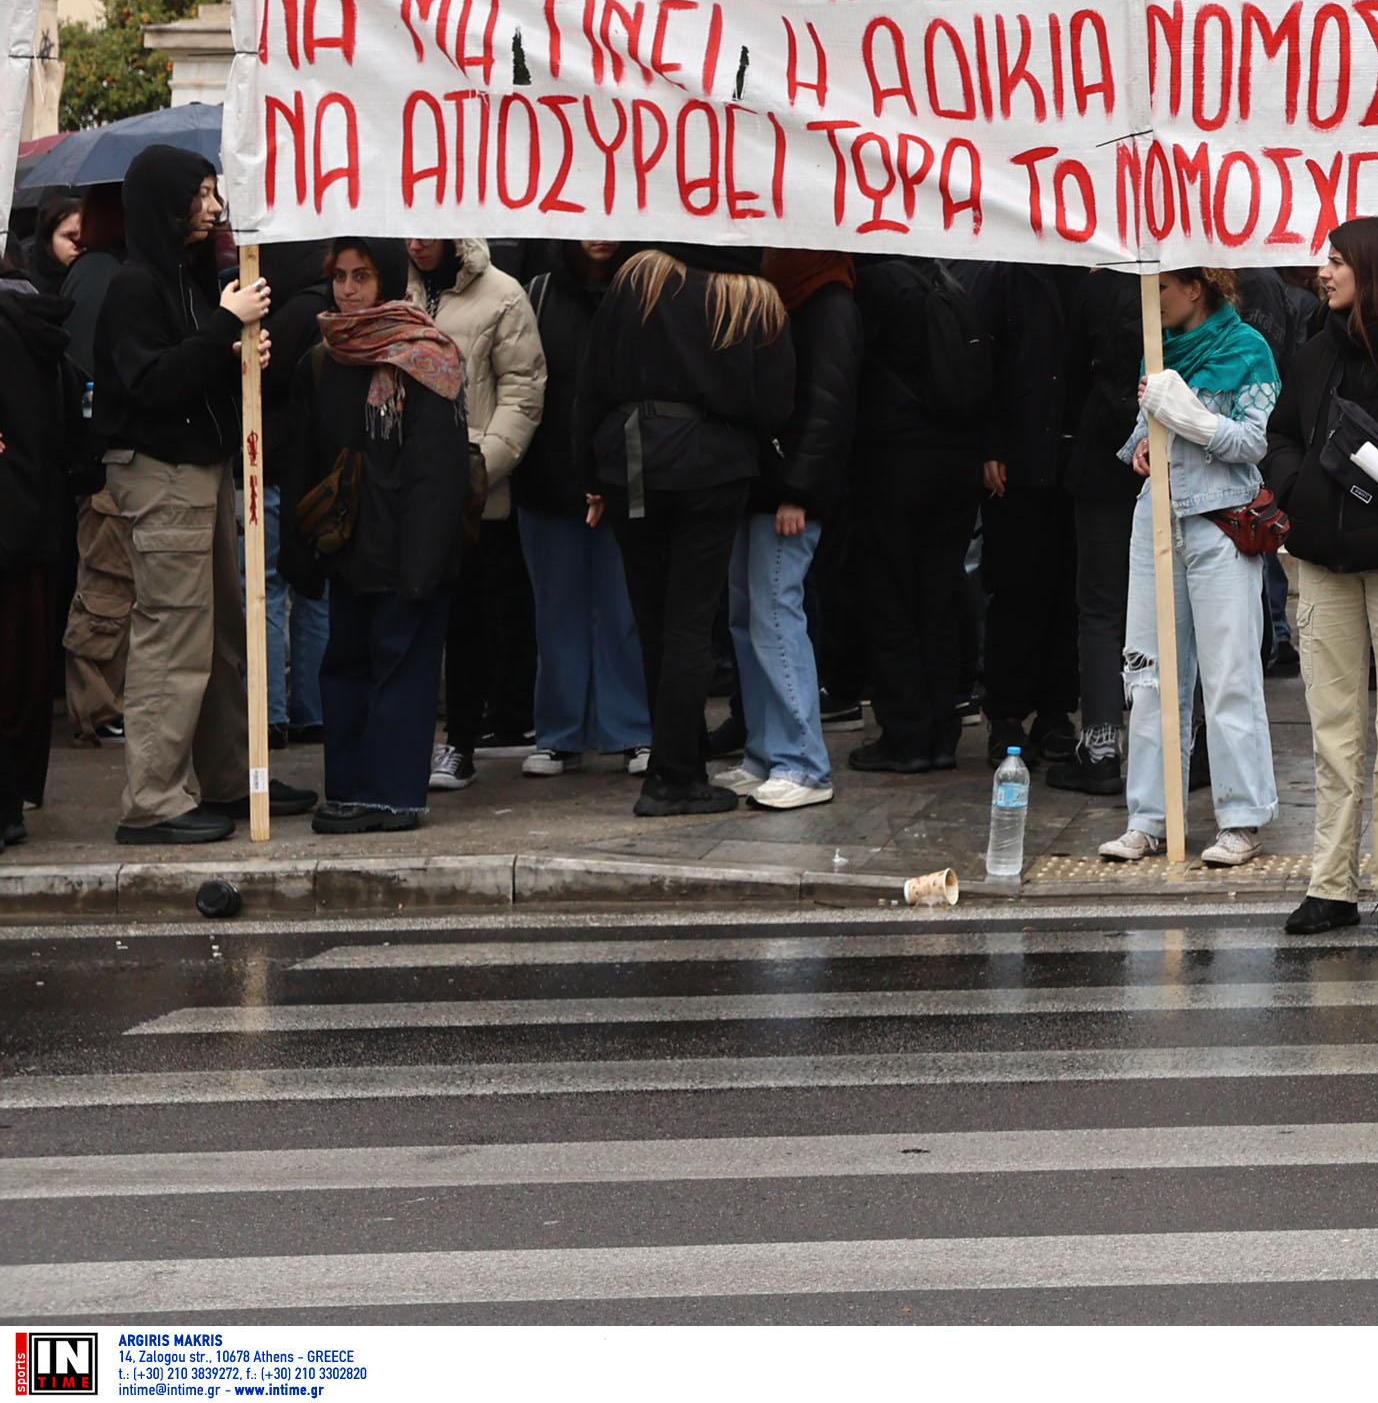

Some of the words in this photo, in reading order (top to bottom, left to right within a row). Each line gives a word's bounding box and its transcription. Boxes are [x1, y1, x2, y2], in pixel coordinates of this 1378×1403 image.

[784, 18, 829, 109] Η
[863, 11, 1116, 124] ΑΔΙΚΙΑ
[266, 91, 361, 215] ΝΑ
[403, 91, 787, 221] ΑΠΟΣΥΡΘΕΙ
[807, 121, 983, 236] ΤΩΡΑ
[1011, 147, 1098, 244] ΤΟ
